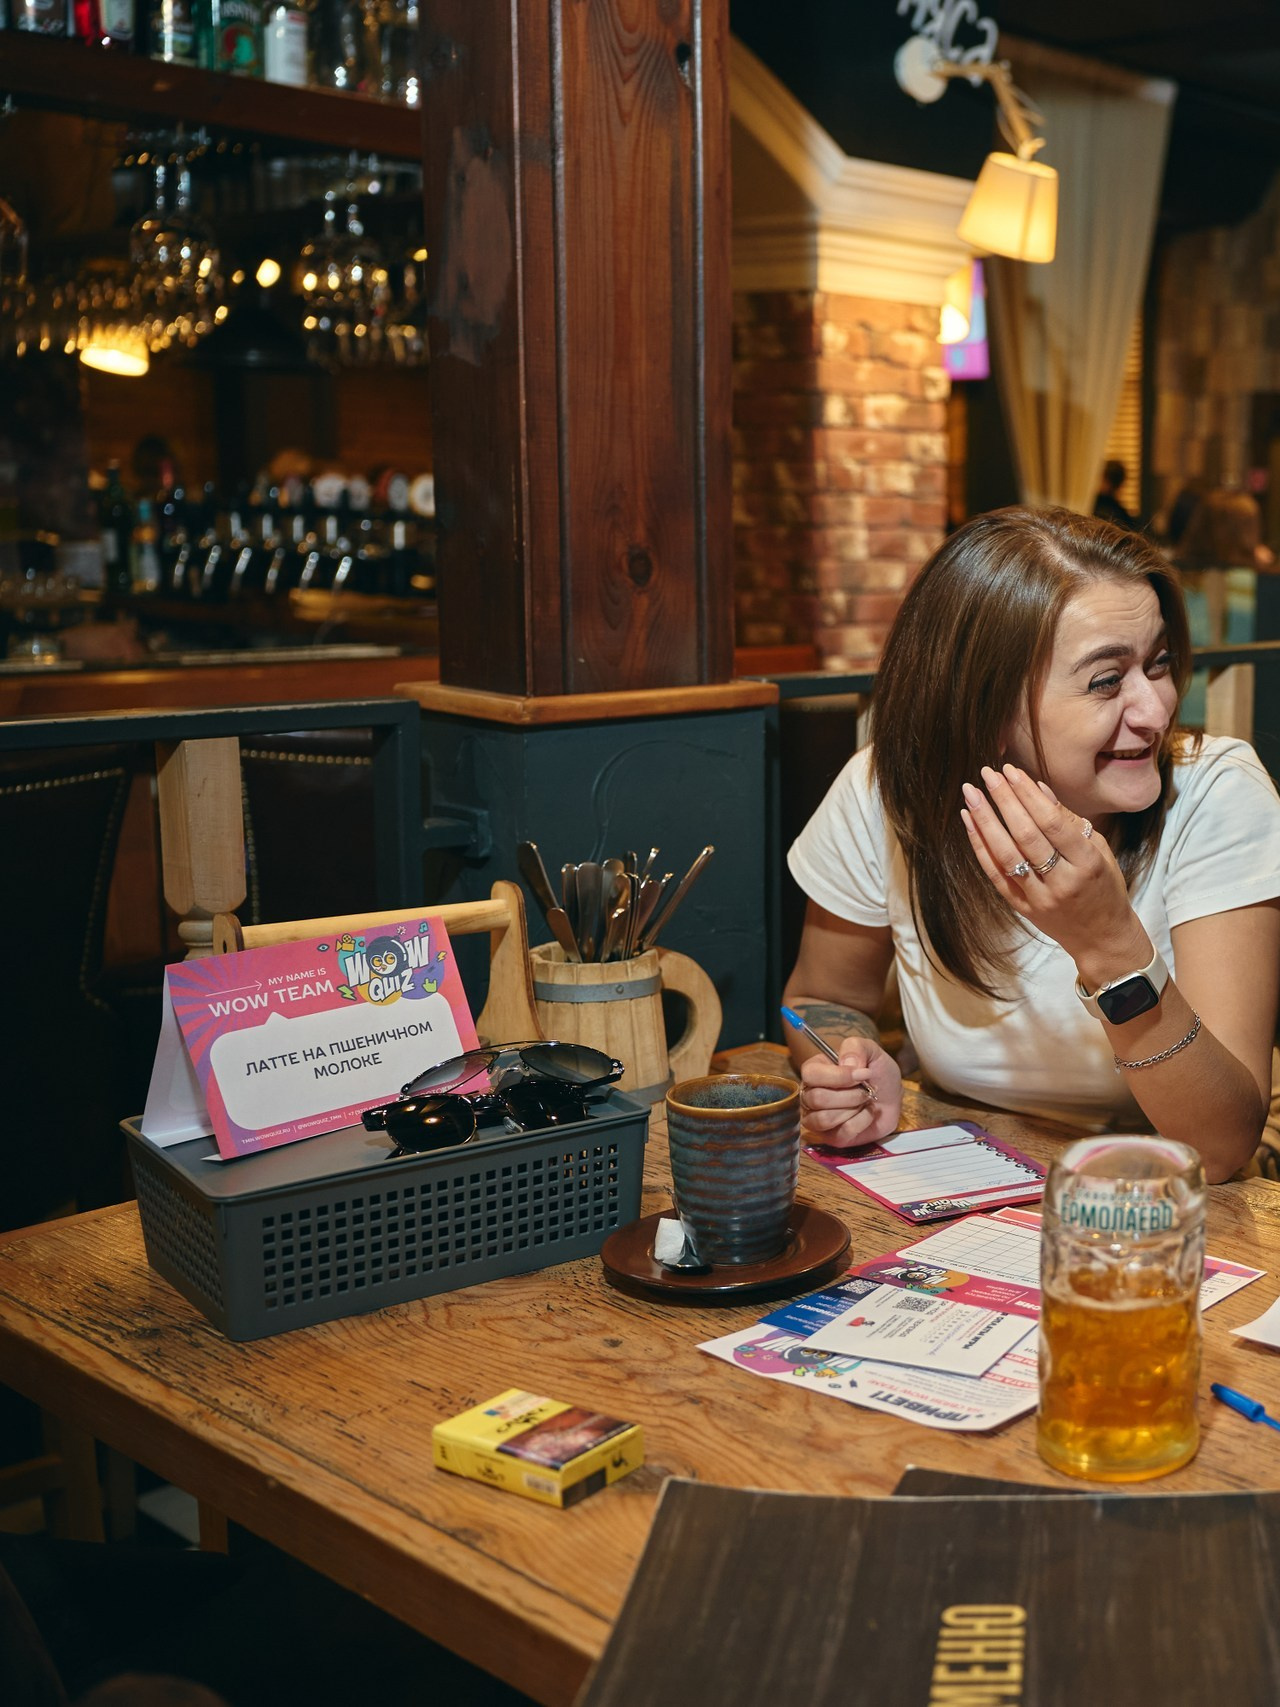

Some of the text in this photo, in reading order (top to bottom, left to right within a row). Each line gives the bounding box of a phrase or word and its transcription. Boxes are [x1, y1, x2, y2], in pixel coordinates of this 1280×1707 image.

[268, 967, 327, 986] MY NAME IS
[368, 968, 416, 1002] QUIZ
[208, 980, 335, 1018] WOW TEAM
[245, 1021, 433, 1076] ЛАТТЕ НА ПШЕНИЧНОМ
[314, 1052, 382, 1080] МОЛОКЕ
[1061, 1193, 1173, 1231] ЕРМОЛАЕВЪ
[868, 1390, 969, 1422] ПРИВЕТ!
[927, 1604, 1027, 1707] МЕНЮ
